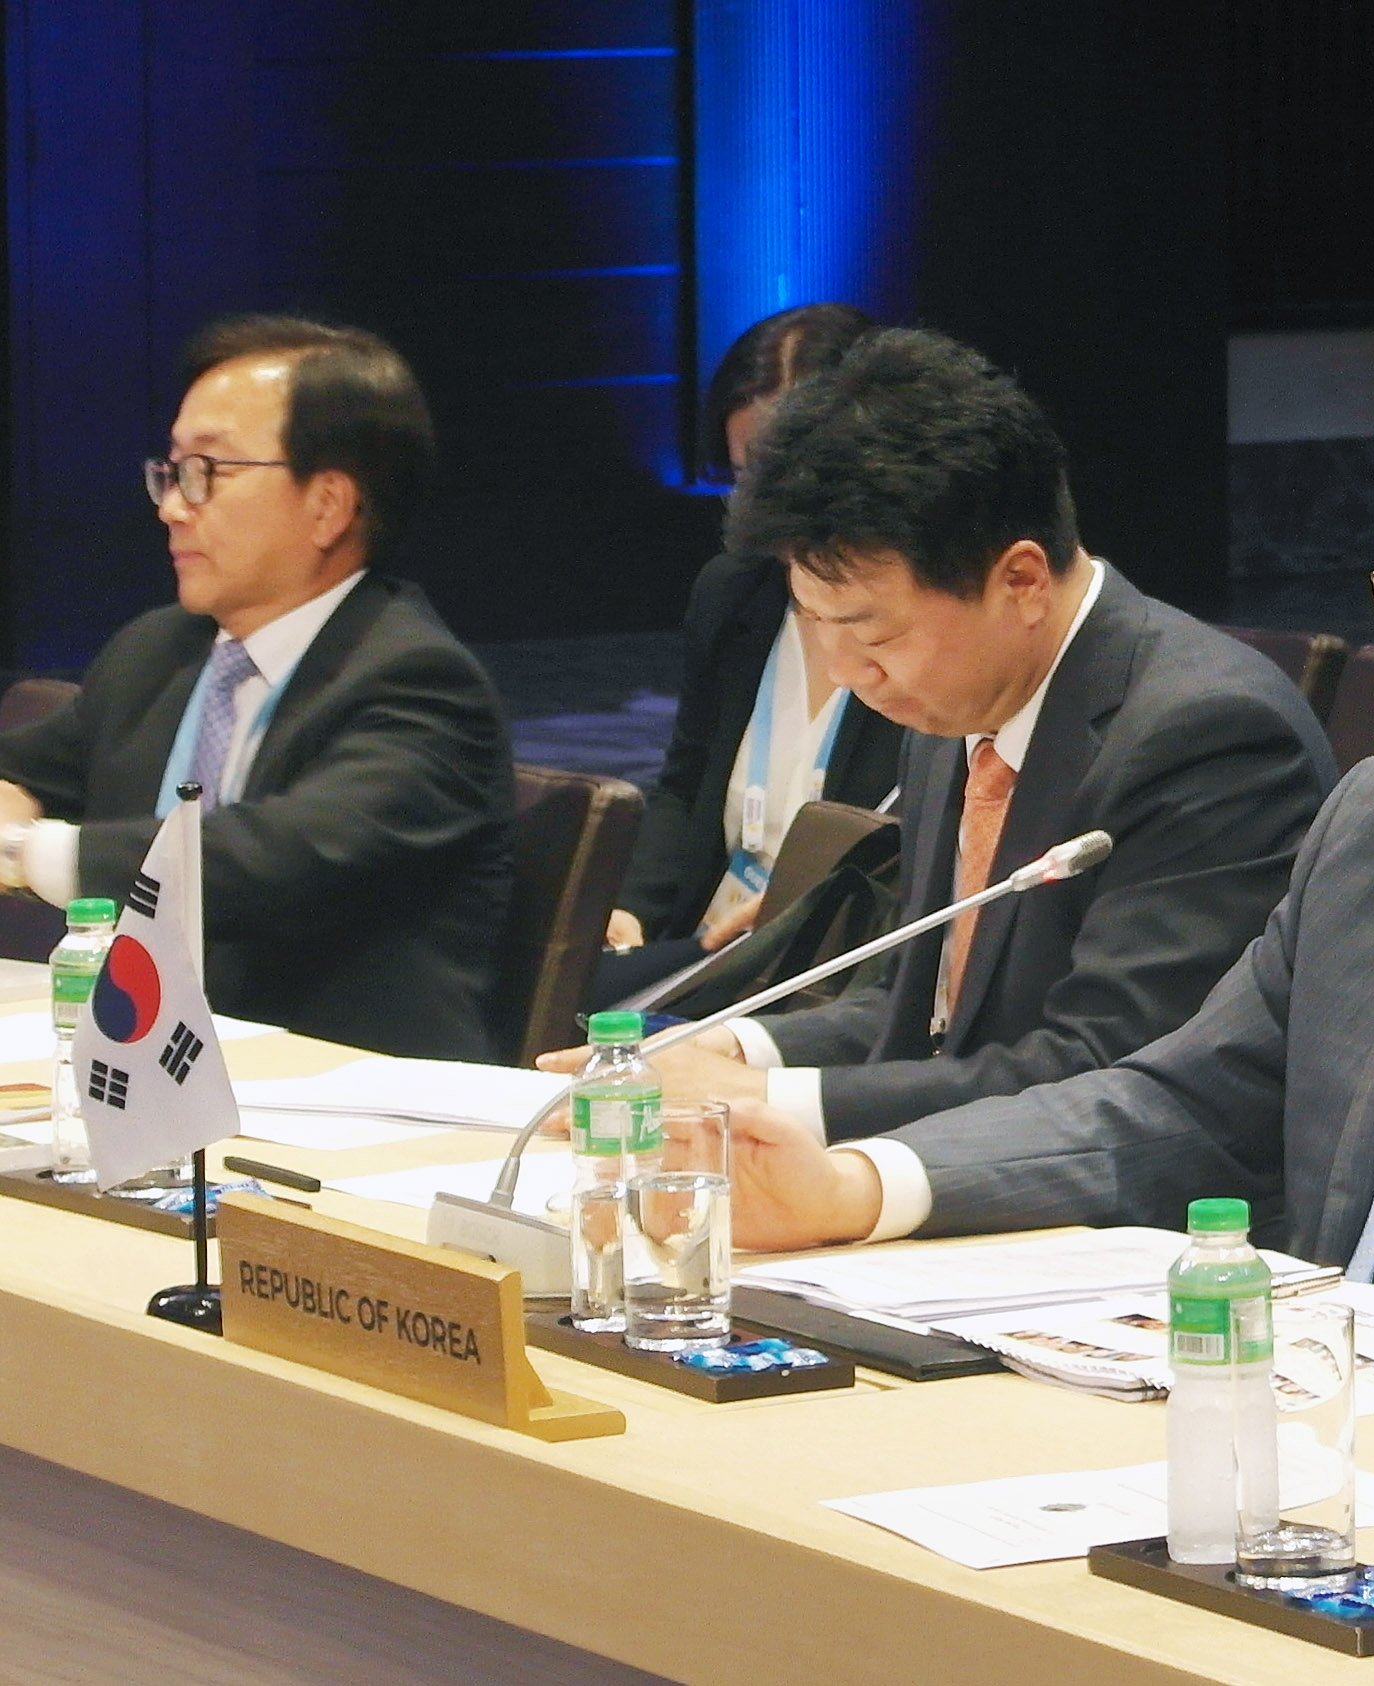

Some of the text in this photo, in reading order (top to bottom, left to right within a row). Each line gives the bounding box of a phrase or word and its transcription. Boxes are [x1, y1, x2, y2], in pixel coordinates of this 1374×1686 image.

[239, 1260, 482, 1365] REPUBLIC OF KOREA
